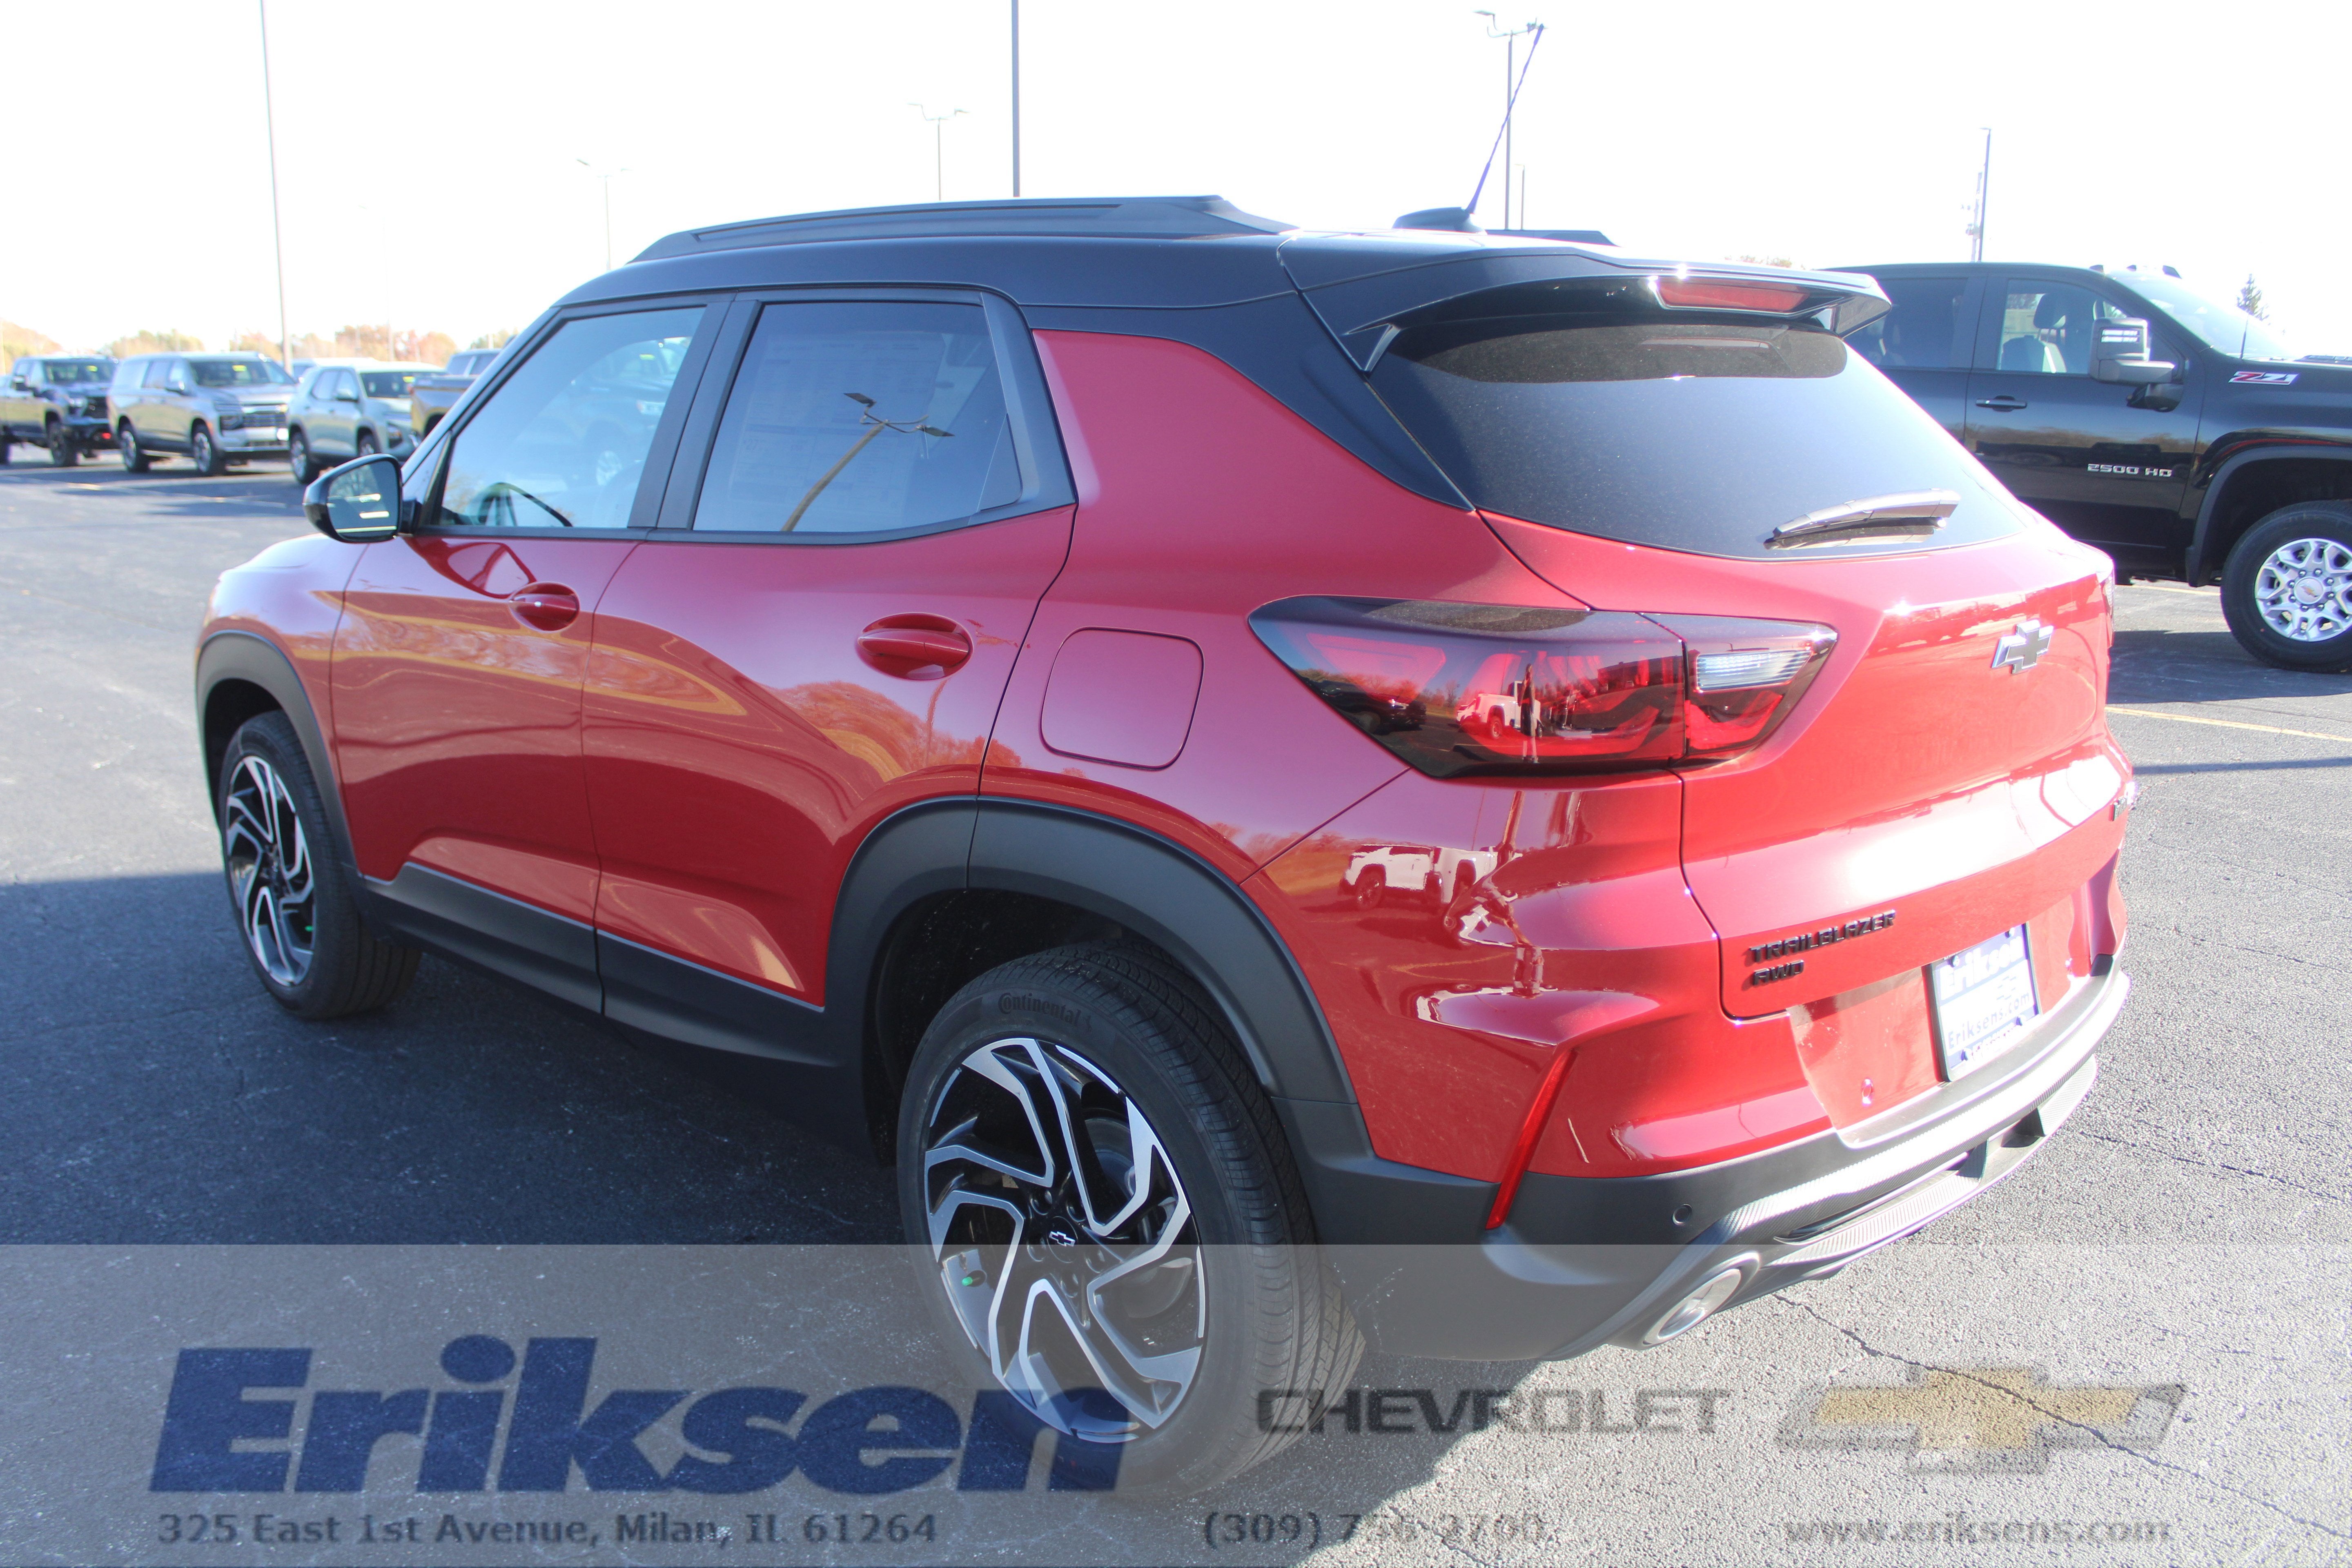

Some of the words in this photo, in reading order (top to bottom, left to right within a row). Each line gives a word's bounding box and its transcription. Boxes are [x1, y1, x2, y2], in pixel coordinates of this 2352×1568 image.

[2228, 371, 2299, 385] Z71
[2087, 463, 2140, 475] 2500
[2145, 468, 2172, 477] HD
[1749, 909, 1896, 962] TRAILBLAZER
[1753, 960, 1804, 985] AWD
[1939, 936, 2024, 1000] Eriksen
[998, 992, 1082, 1027] Continental
[1948, 992, 2030, 1050] Eriksens.com
